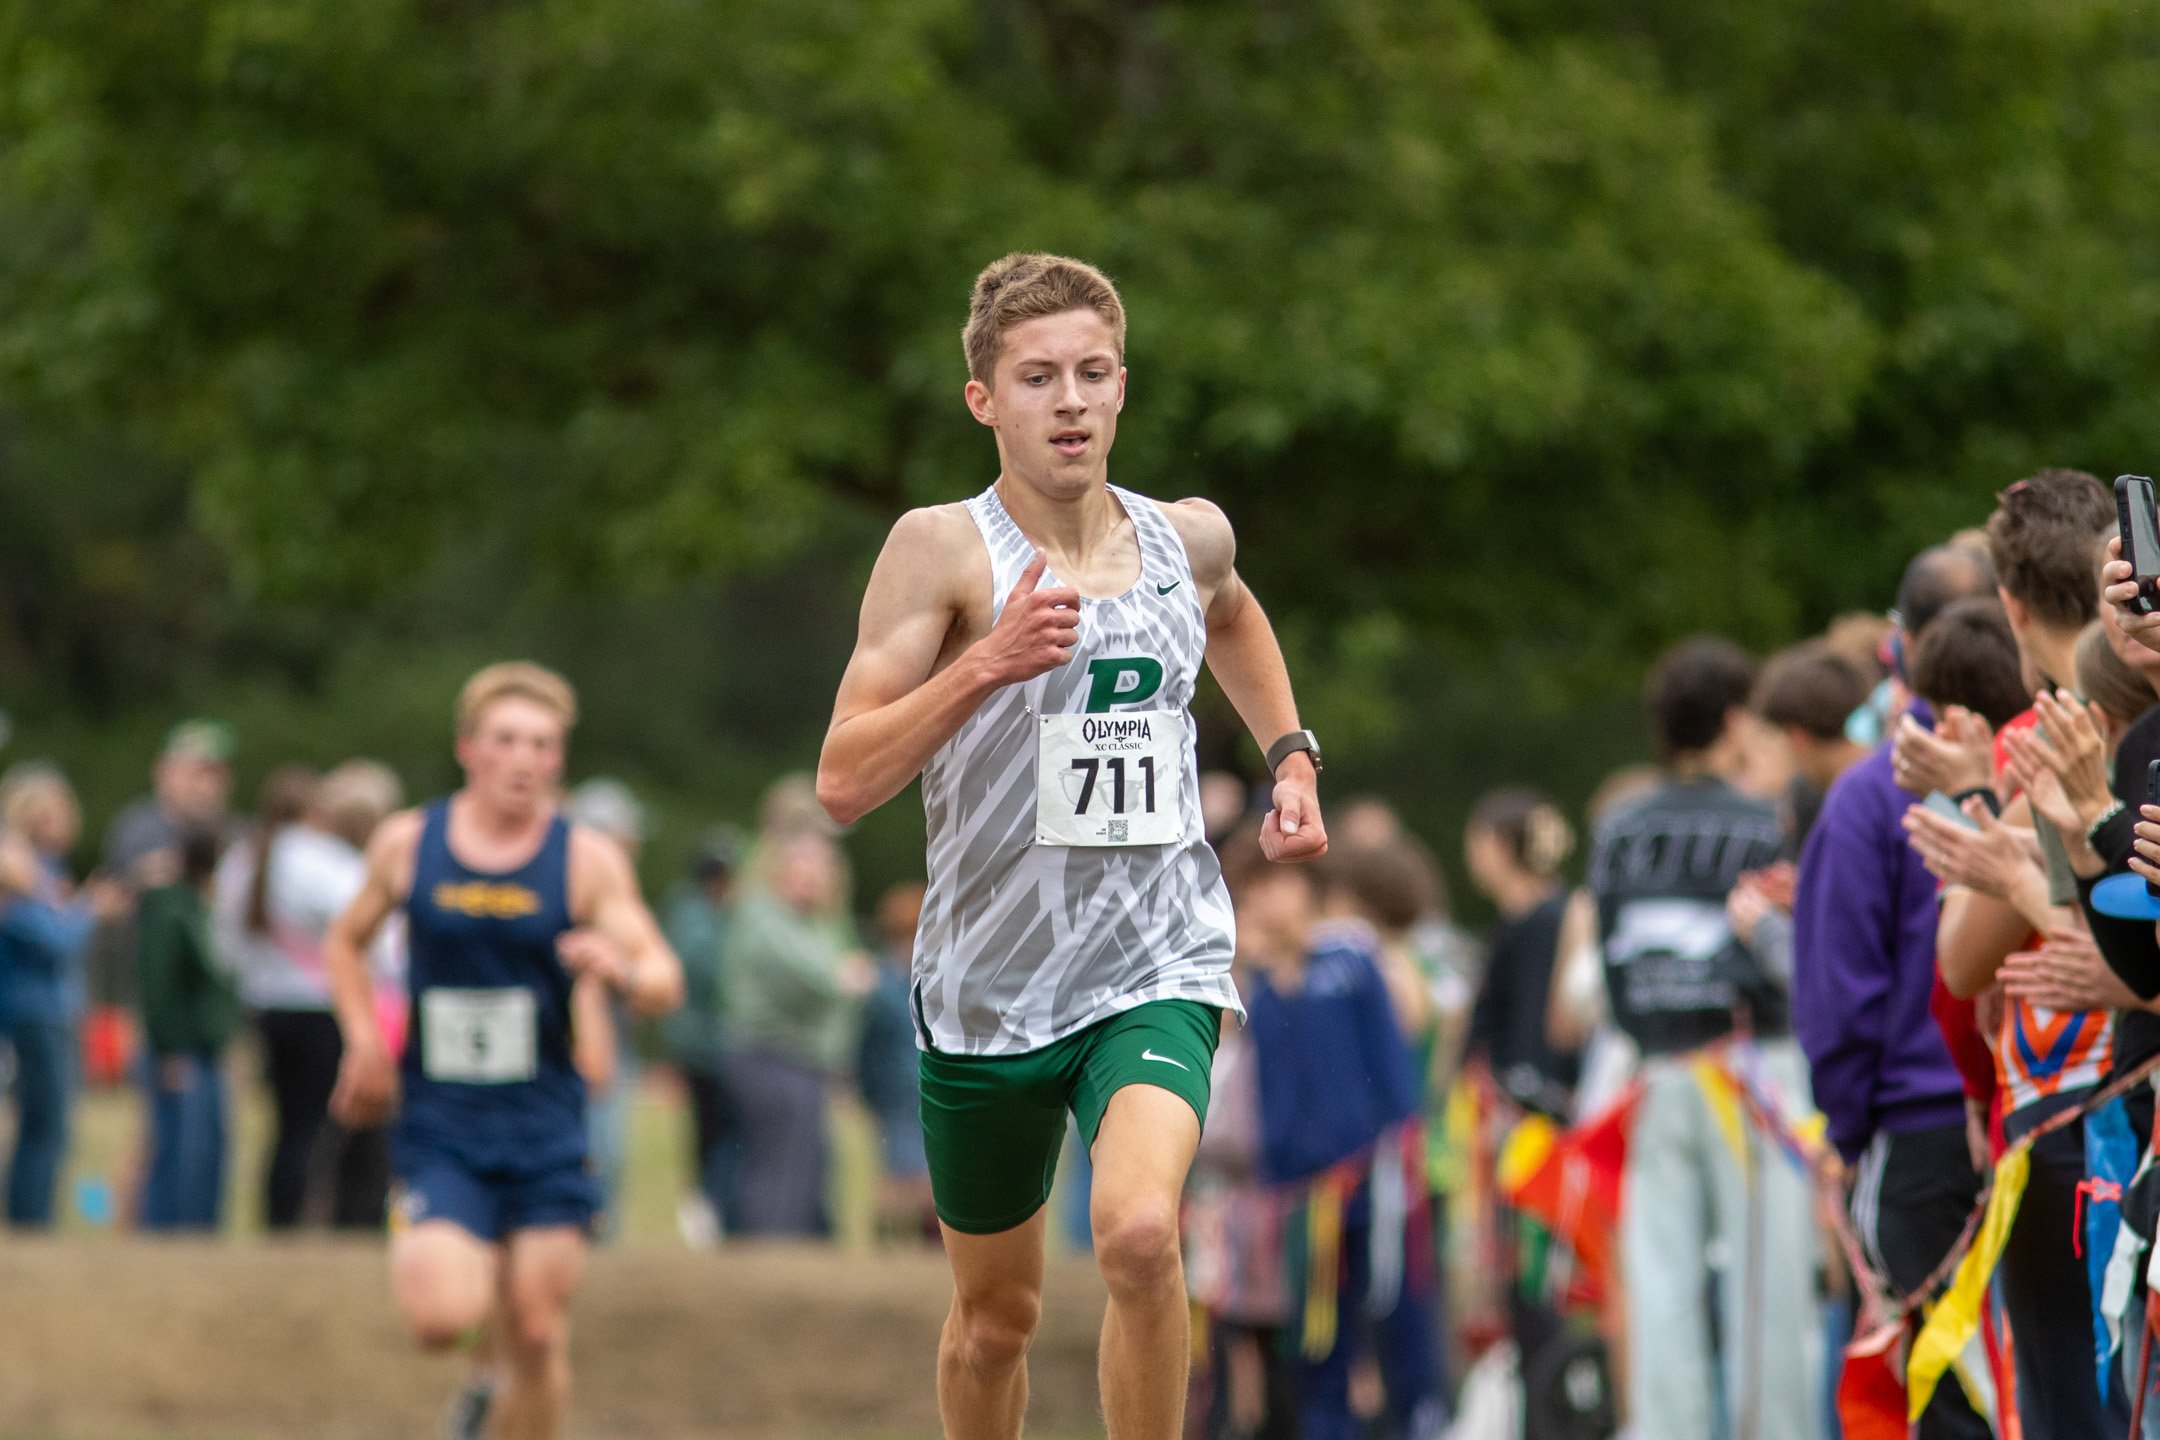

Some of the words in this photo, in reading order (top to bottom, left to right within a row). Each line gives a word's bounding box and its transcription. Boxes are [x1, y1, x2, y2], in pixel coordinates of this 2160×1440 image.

[1085, 656, 1164, 713] P
[1082, 717, 1152, 744] OLYMPIA
[1094, 743, 1107, 752] XC
[1108, 742, 1144, 751] CLASSIC
[1071, 756, 1156, 815] 711
